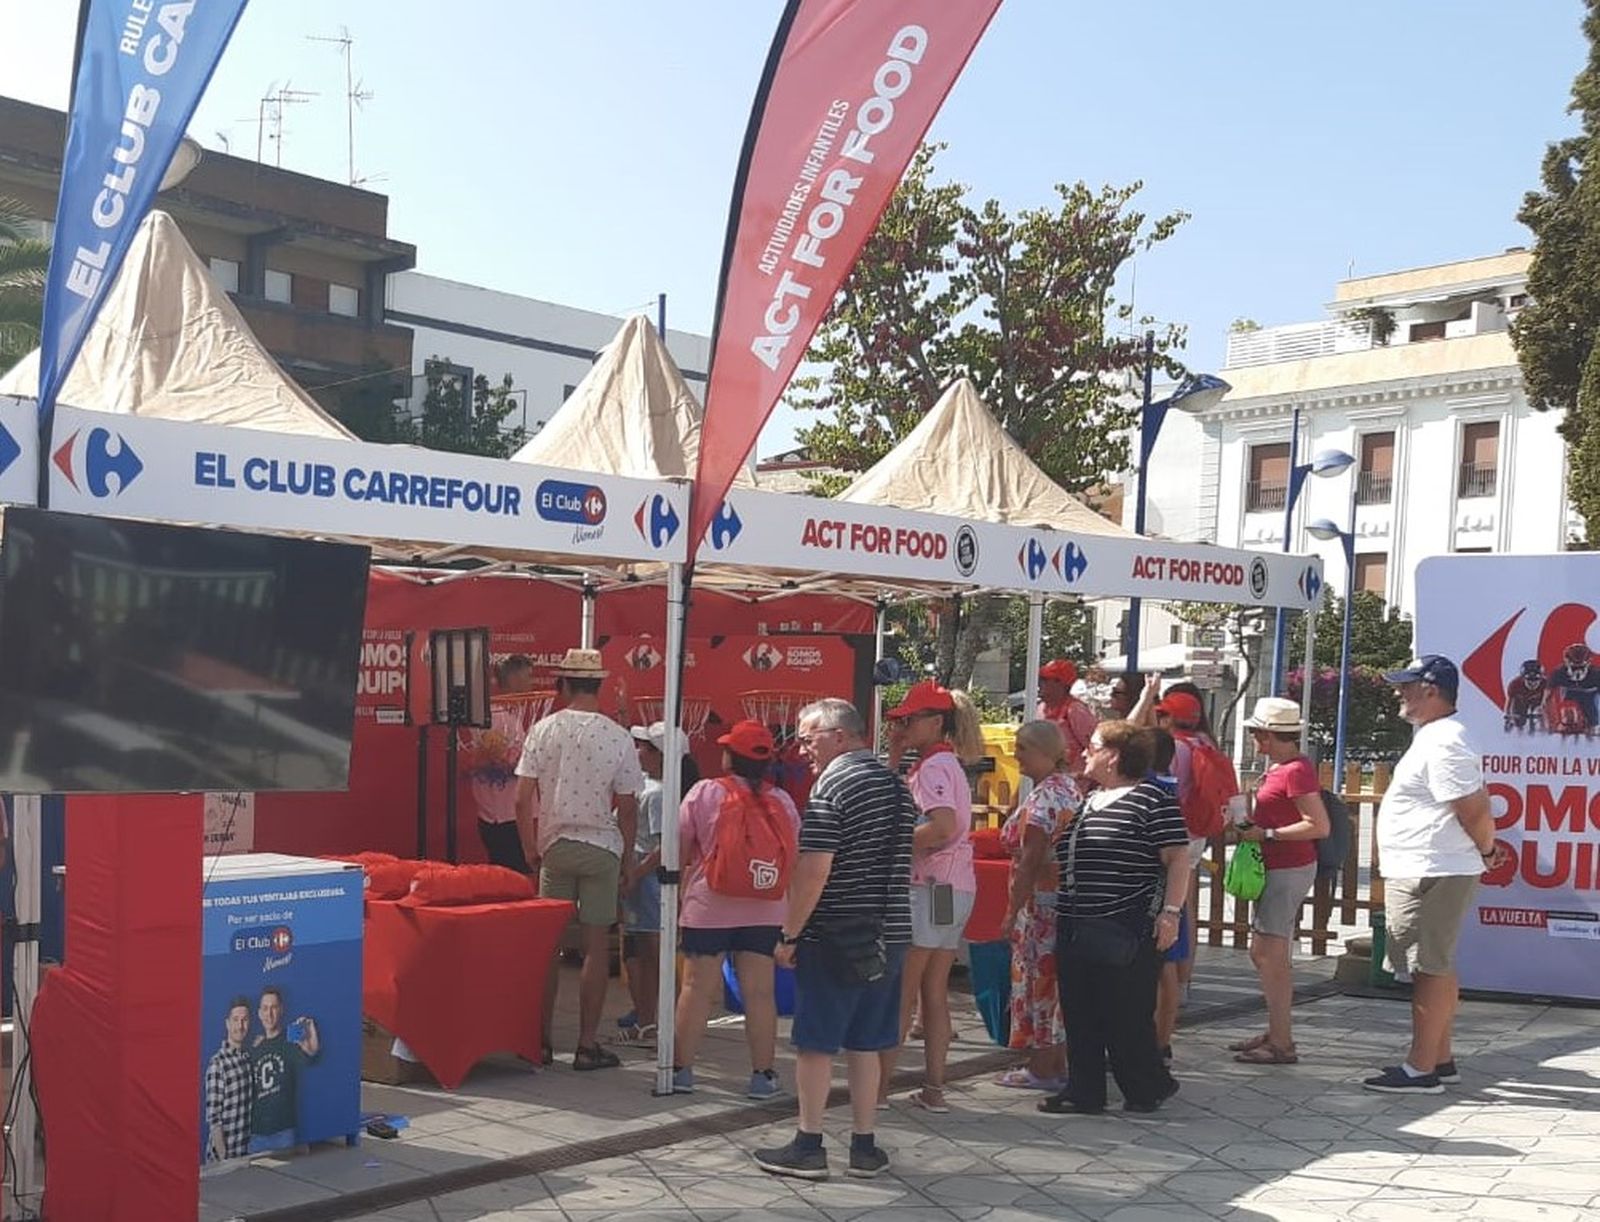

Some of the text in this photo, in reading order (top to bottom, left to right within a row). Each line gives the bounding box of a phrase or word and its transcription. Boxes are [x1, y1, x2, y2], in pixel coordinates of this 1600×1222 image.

[65, 0, 196, 300] EL CLUB CA
[751, 24, 928, 372] ACT FOR FOOD
[758, 99, 850, 276] ACTIVIDADES INFANTILES
[195, 451, 521, 515] EL CLUB CARREFOUR
[542, 492, 582, 512] El Club
[801, 518, 847, 550] ACT
[850, 523, 891, 553] FOR
[895, 529, 947, 560] FOOD
[1132, 555, 1167, 580] ACT
[1169, 558, 1200, 583] FOR
[1203, 563, 1244, 586] FOOD
[360, 643, 406, 667] MO
[357, 670, 406, 694] UIP
[1526, 757, 1557, 775] CON
[1562, 757, 1582, 776] LA
[1483, 910, 1497, 923] LA
[1500, 911, 1542, 926] VUELTA
[235, 936, 270, 951] El Club
